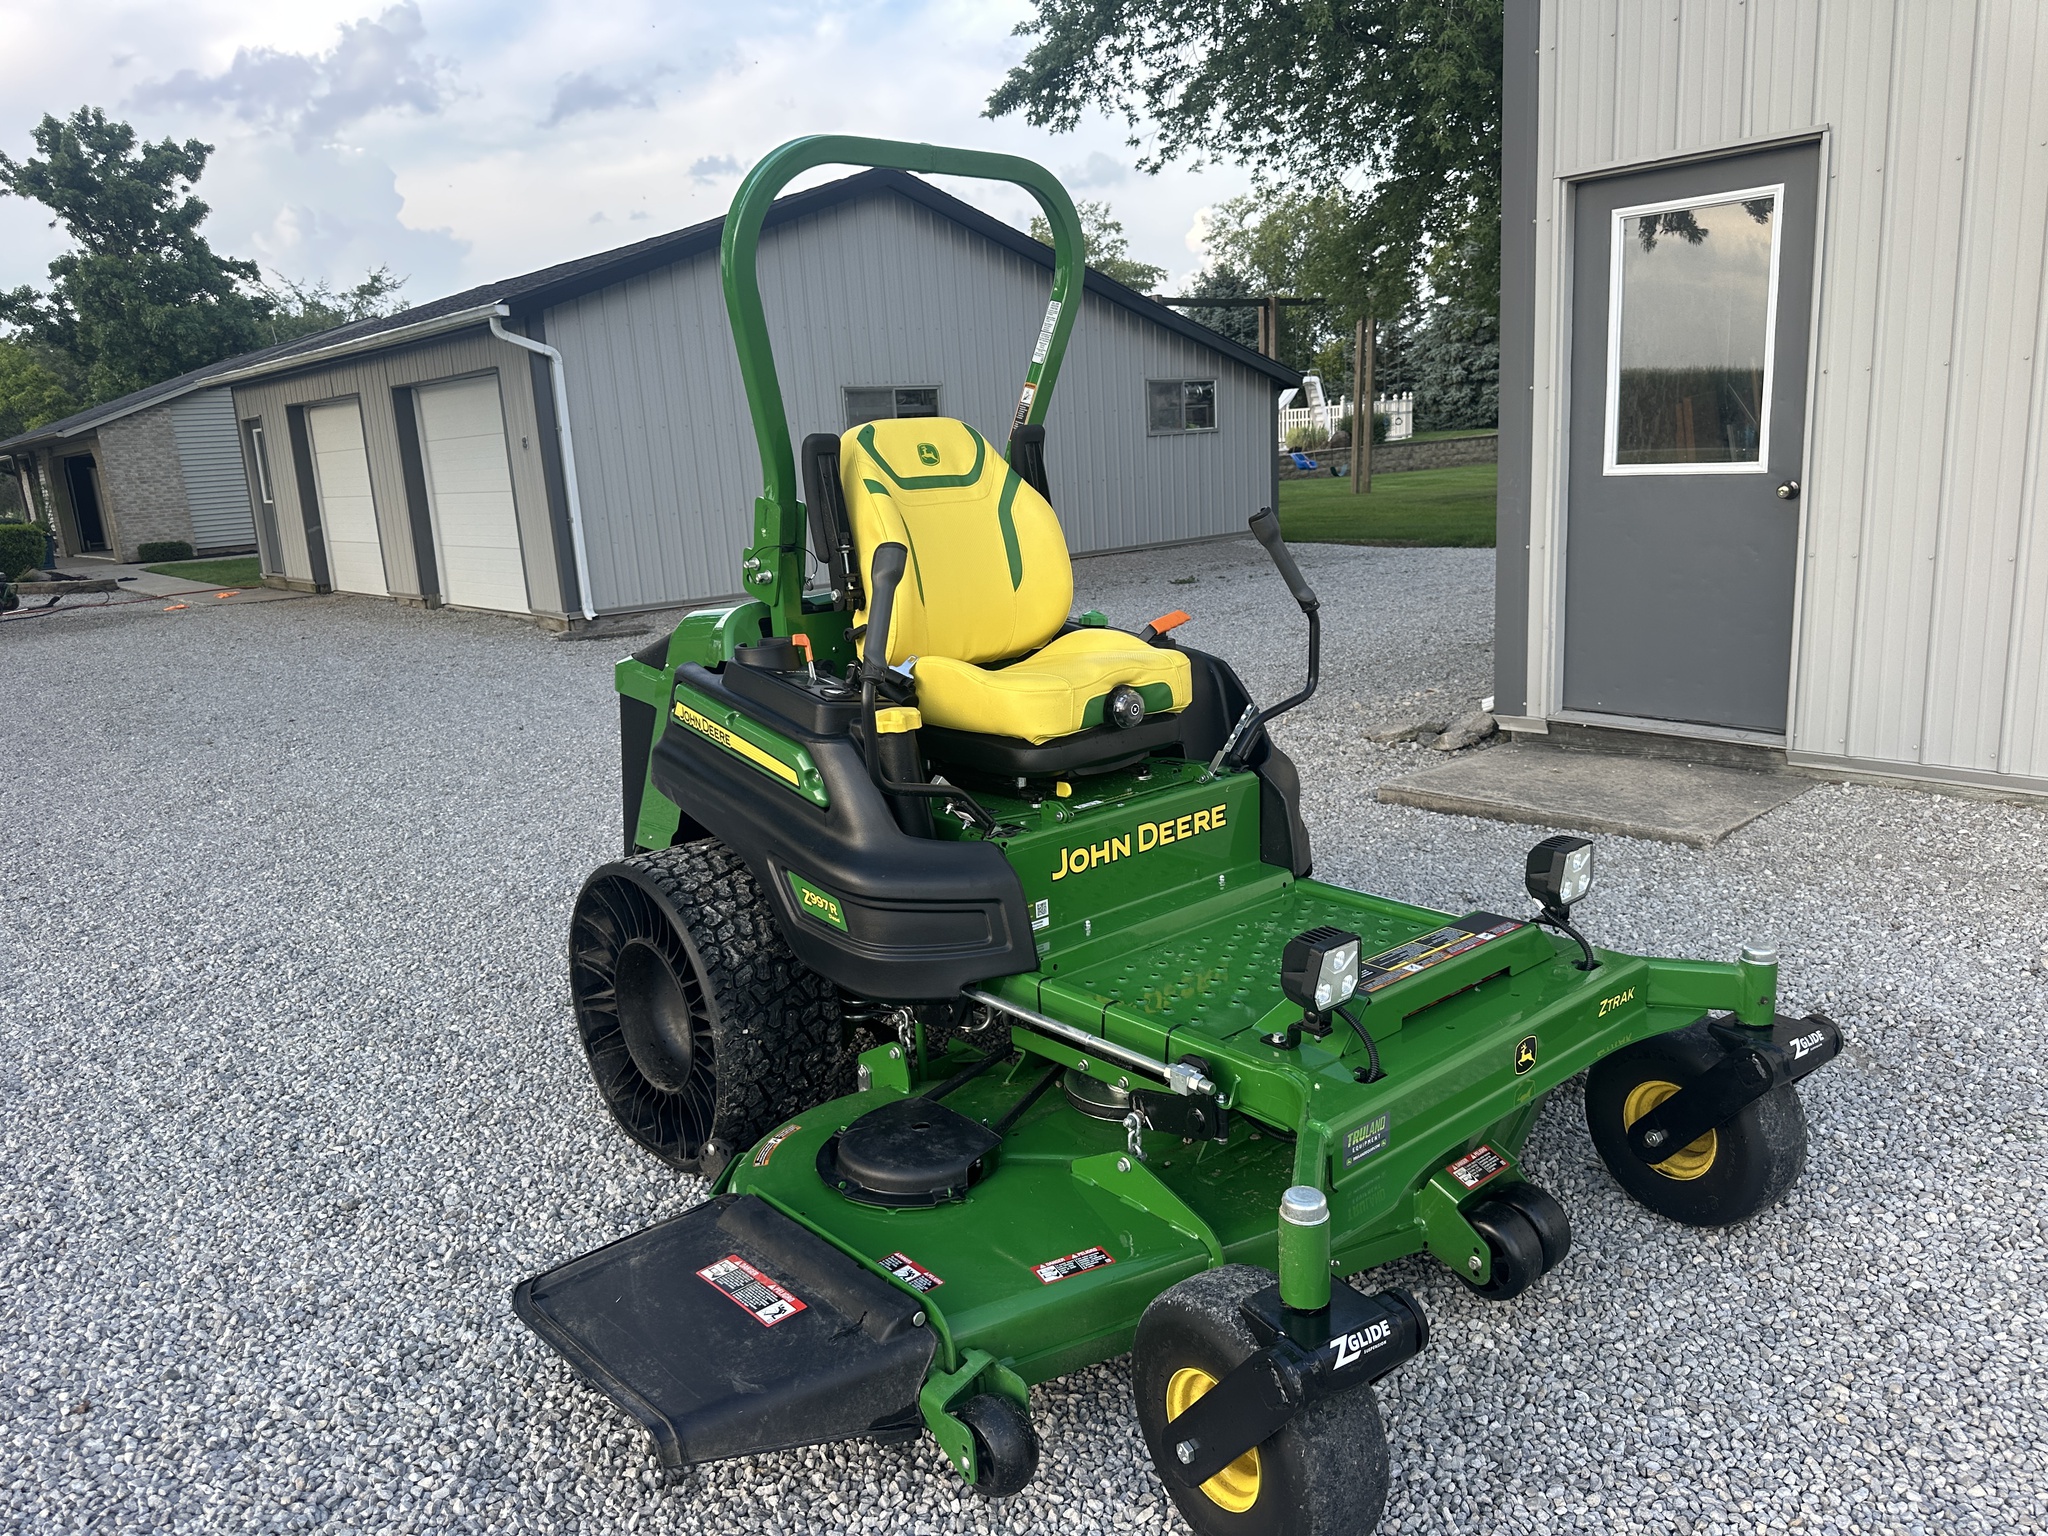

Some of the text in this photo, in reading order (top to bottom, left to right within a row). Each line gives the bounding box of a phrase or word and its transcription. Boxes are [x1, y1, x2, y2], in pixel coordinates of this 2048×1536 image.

[679, 707, 731, 747] JOHN DEERE
[1051, 803, 1227, 882] JOHN DEERE
[1598, 986, 1636, 1018] ZTRAK
[1789, 1030, 1825, 1060] ZGLIDE
[1347, 1115, 1386, 1148] TRULAND
[1352, 1133, 1381, 1153] EQUIPMENT
[739, 1262, 760, 1276] DANGER
[774, 1287, 796, 1302] PELIGRO
[1329, 1319, 1391, 1371] ZGLIDE
